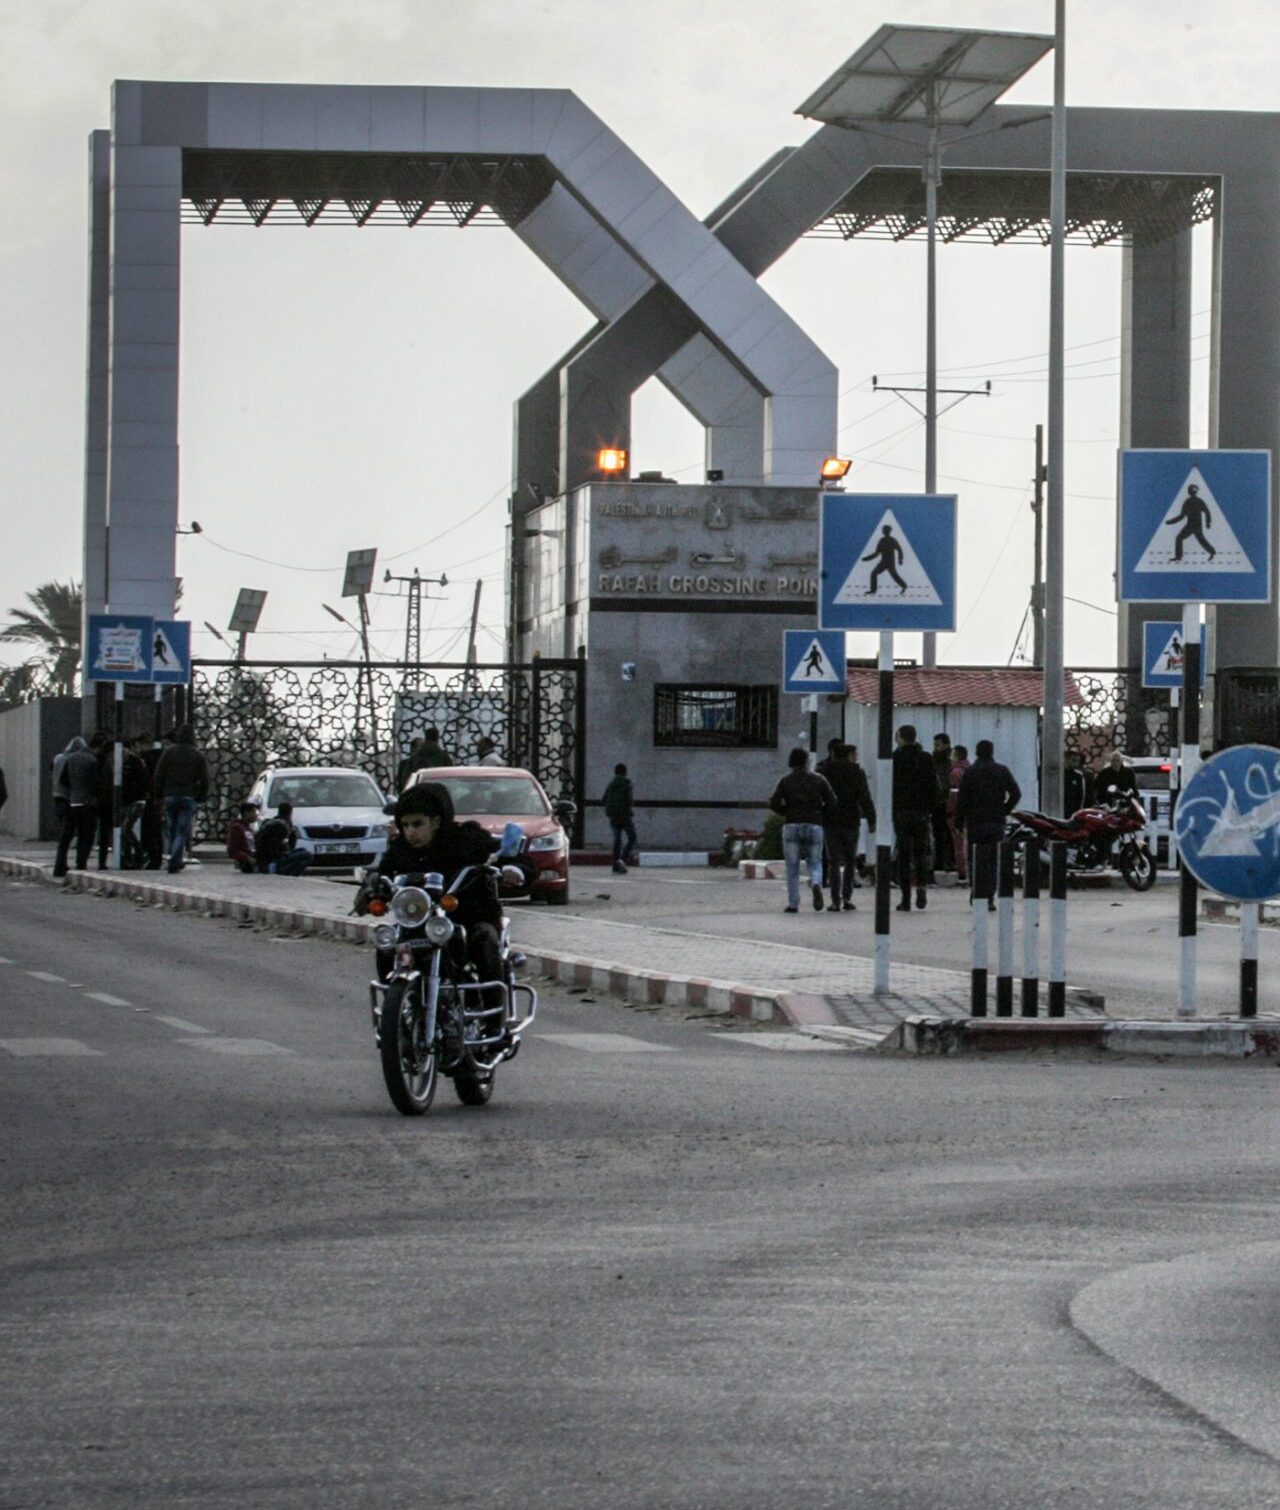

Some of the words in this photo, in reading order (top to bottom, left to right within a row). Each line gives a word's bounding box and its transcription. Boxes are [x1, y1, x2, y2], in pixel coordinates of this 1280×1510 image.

[599, 575, 662, 593] RAFAH
[669, 575, 767, 594] CROSSING
[776, 577, 818, 595] POIN
